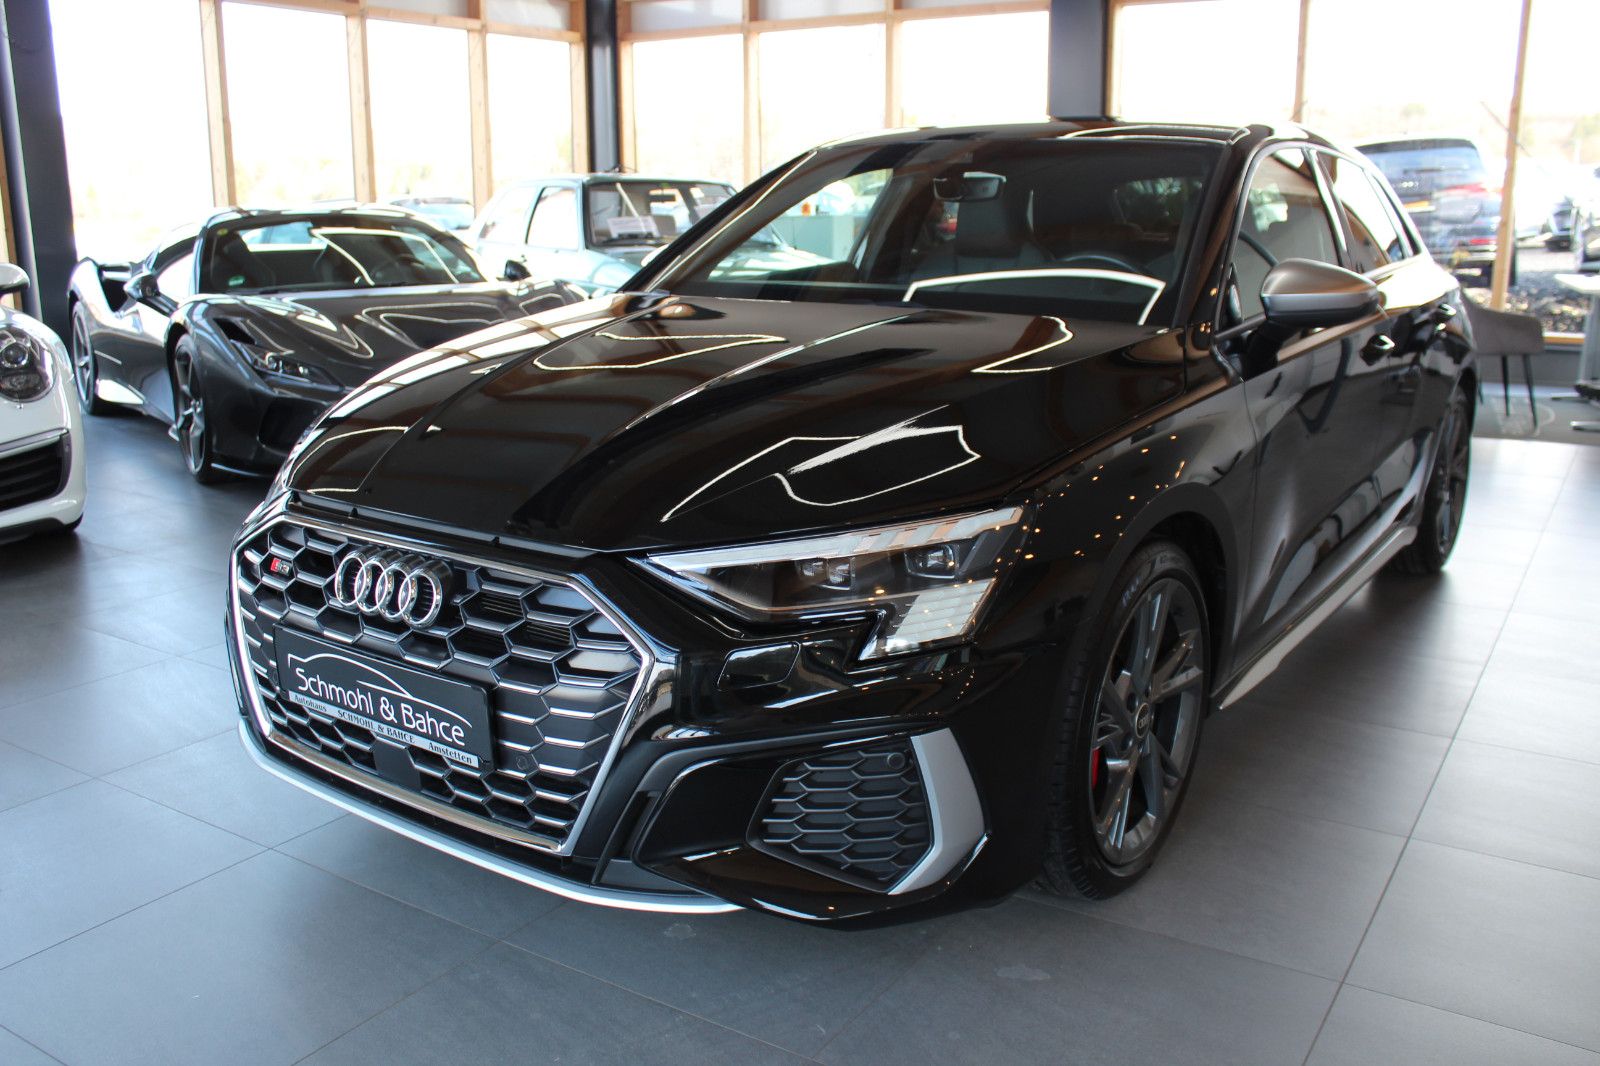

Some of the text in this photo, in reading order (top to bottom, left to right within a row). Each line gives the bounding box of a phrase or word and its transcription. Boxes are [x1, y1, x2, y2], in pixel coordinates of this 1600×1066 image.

[294, 694, 473, 765] Autohaus SCHMOHL & BAHCE Amstetten
[295, 667, 466, 747] Schmohl & Bahce
